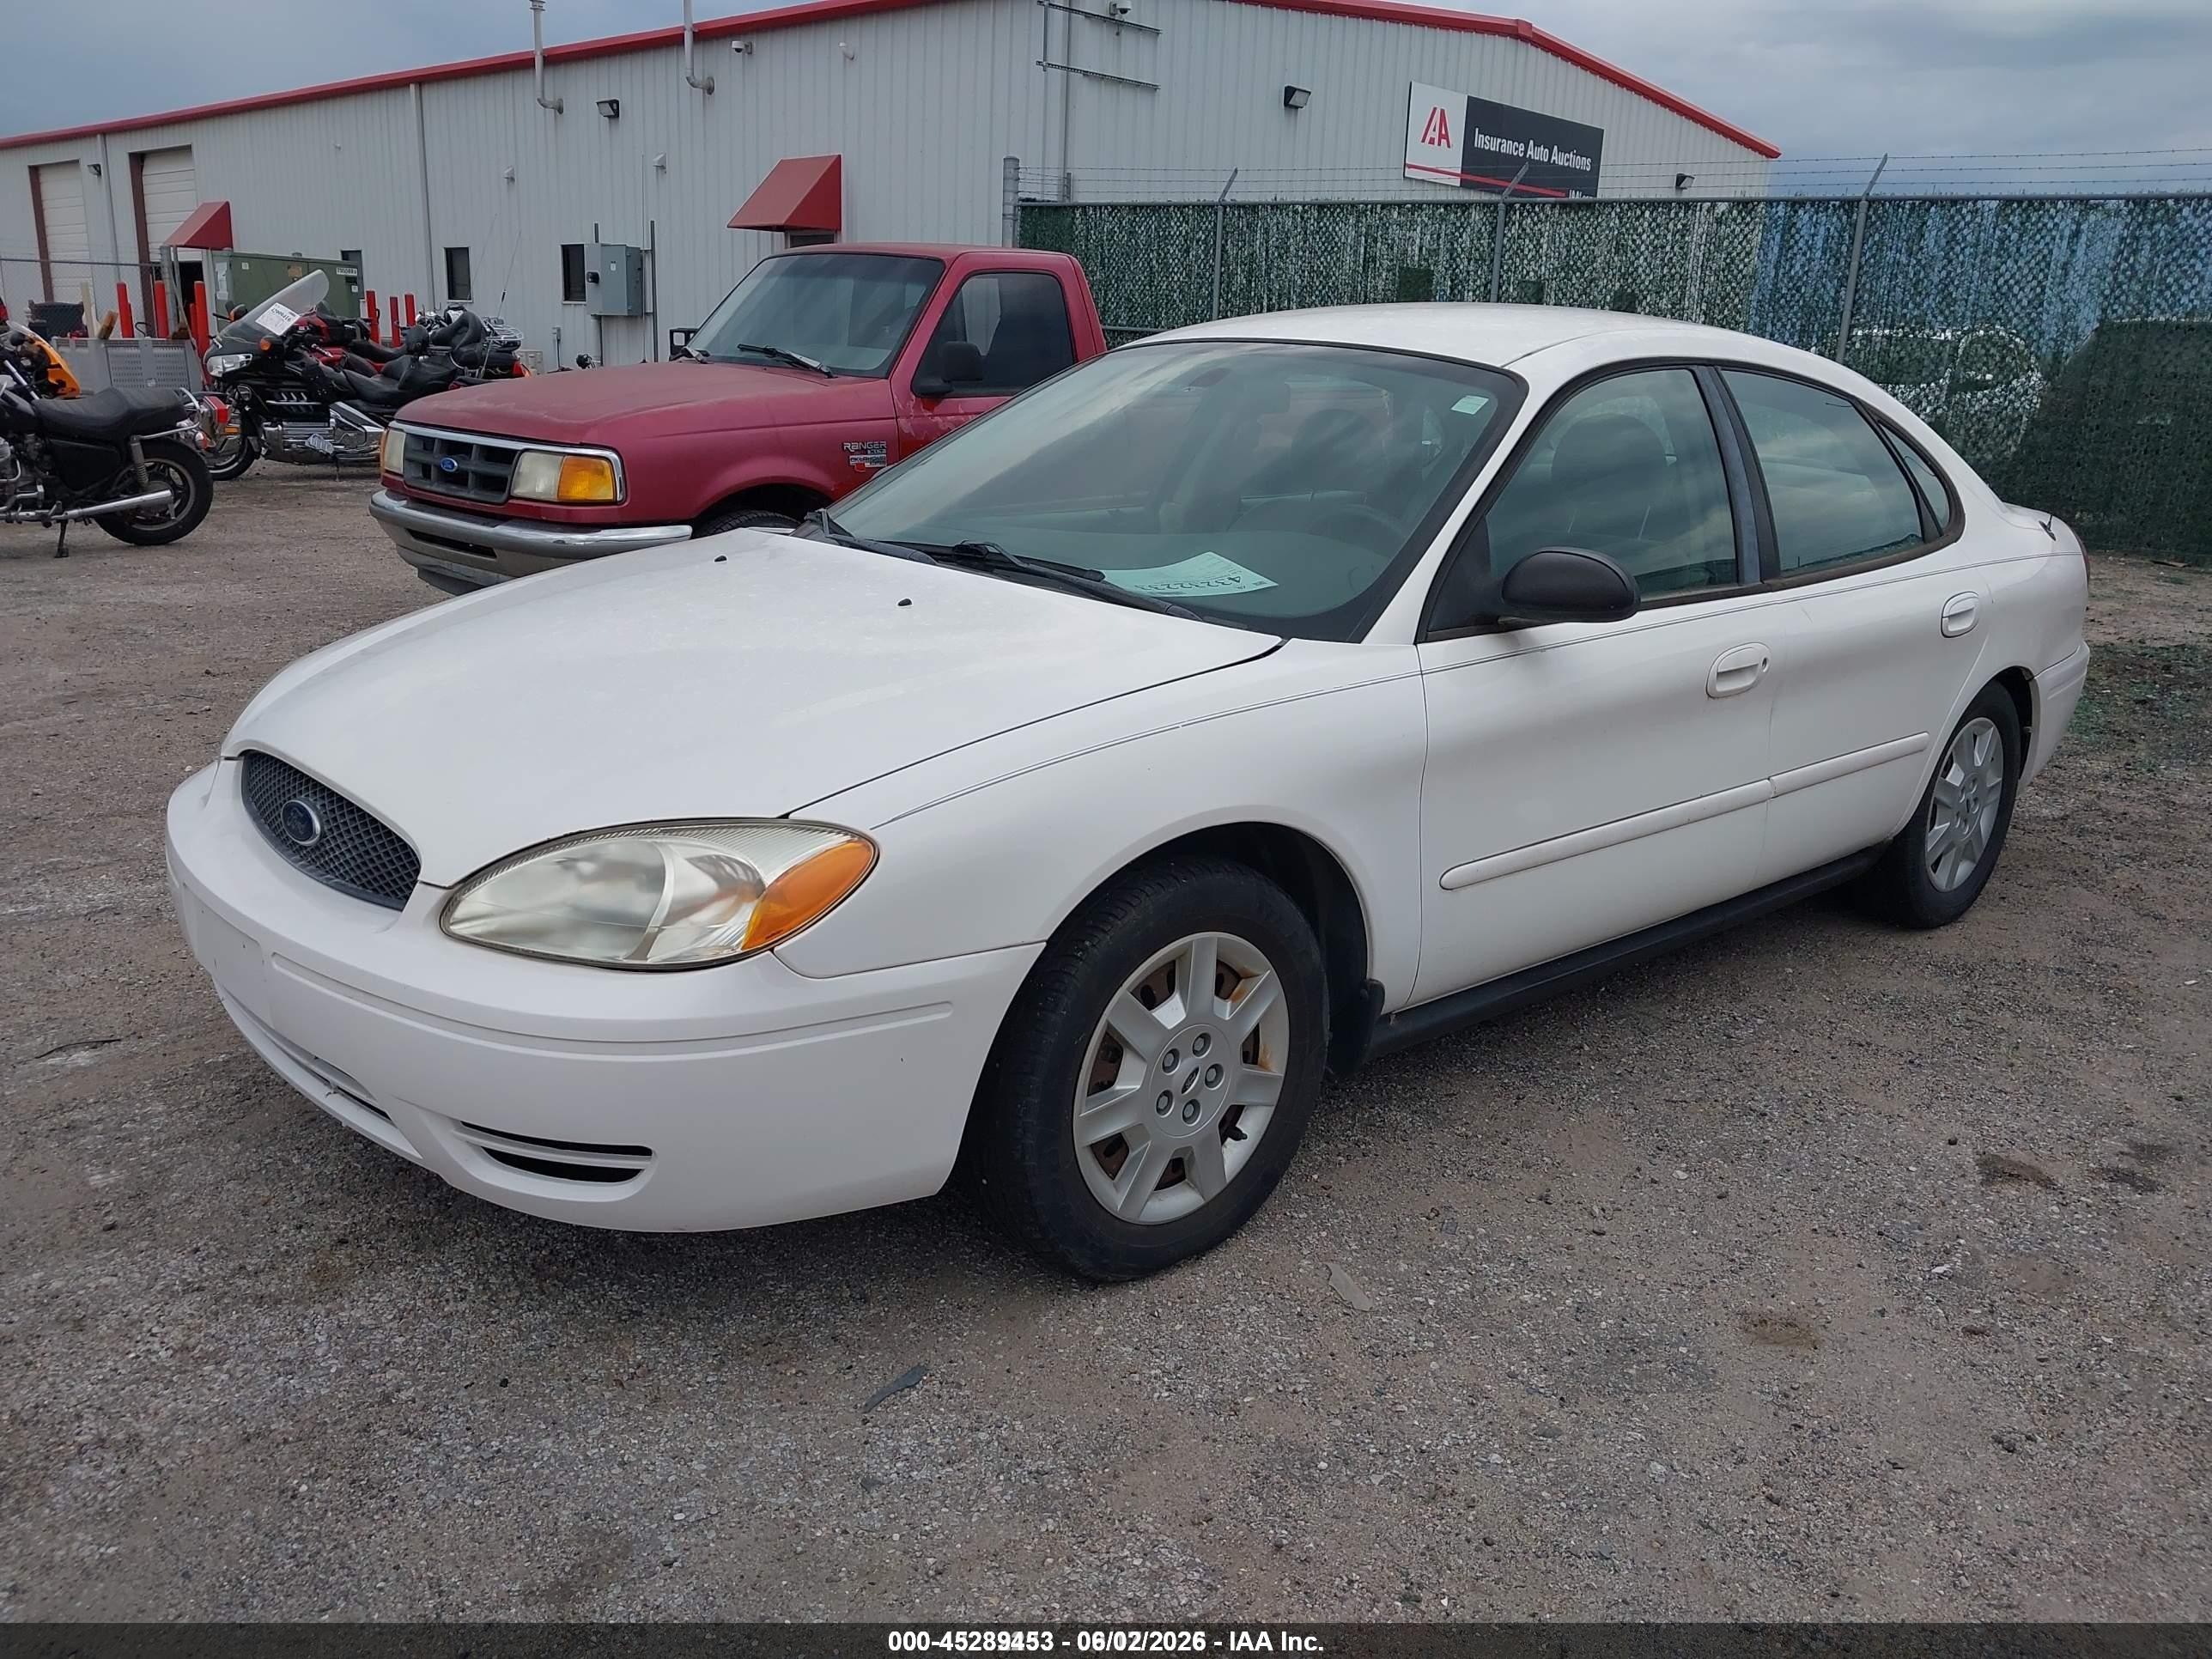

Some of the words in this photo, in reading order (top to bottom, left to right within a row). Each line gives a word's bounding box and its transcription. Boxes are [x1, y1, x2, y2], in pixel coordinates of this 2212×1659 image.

[1474, 127, 1525, 157] Insurance
[1526, 139, 1549, 162] Auto
[1550, 144, 1592, 172] Auctions
[843, 441, 887, 452] RANGER
